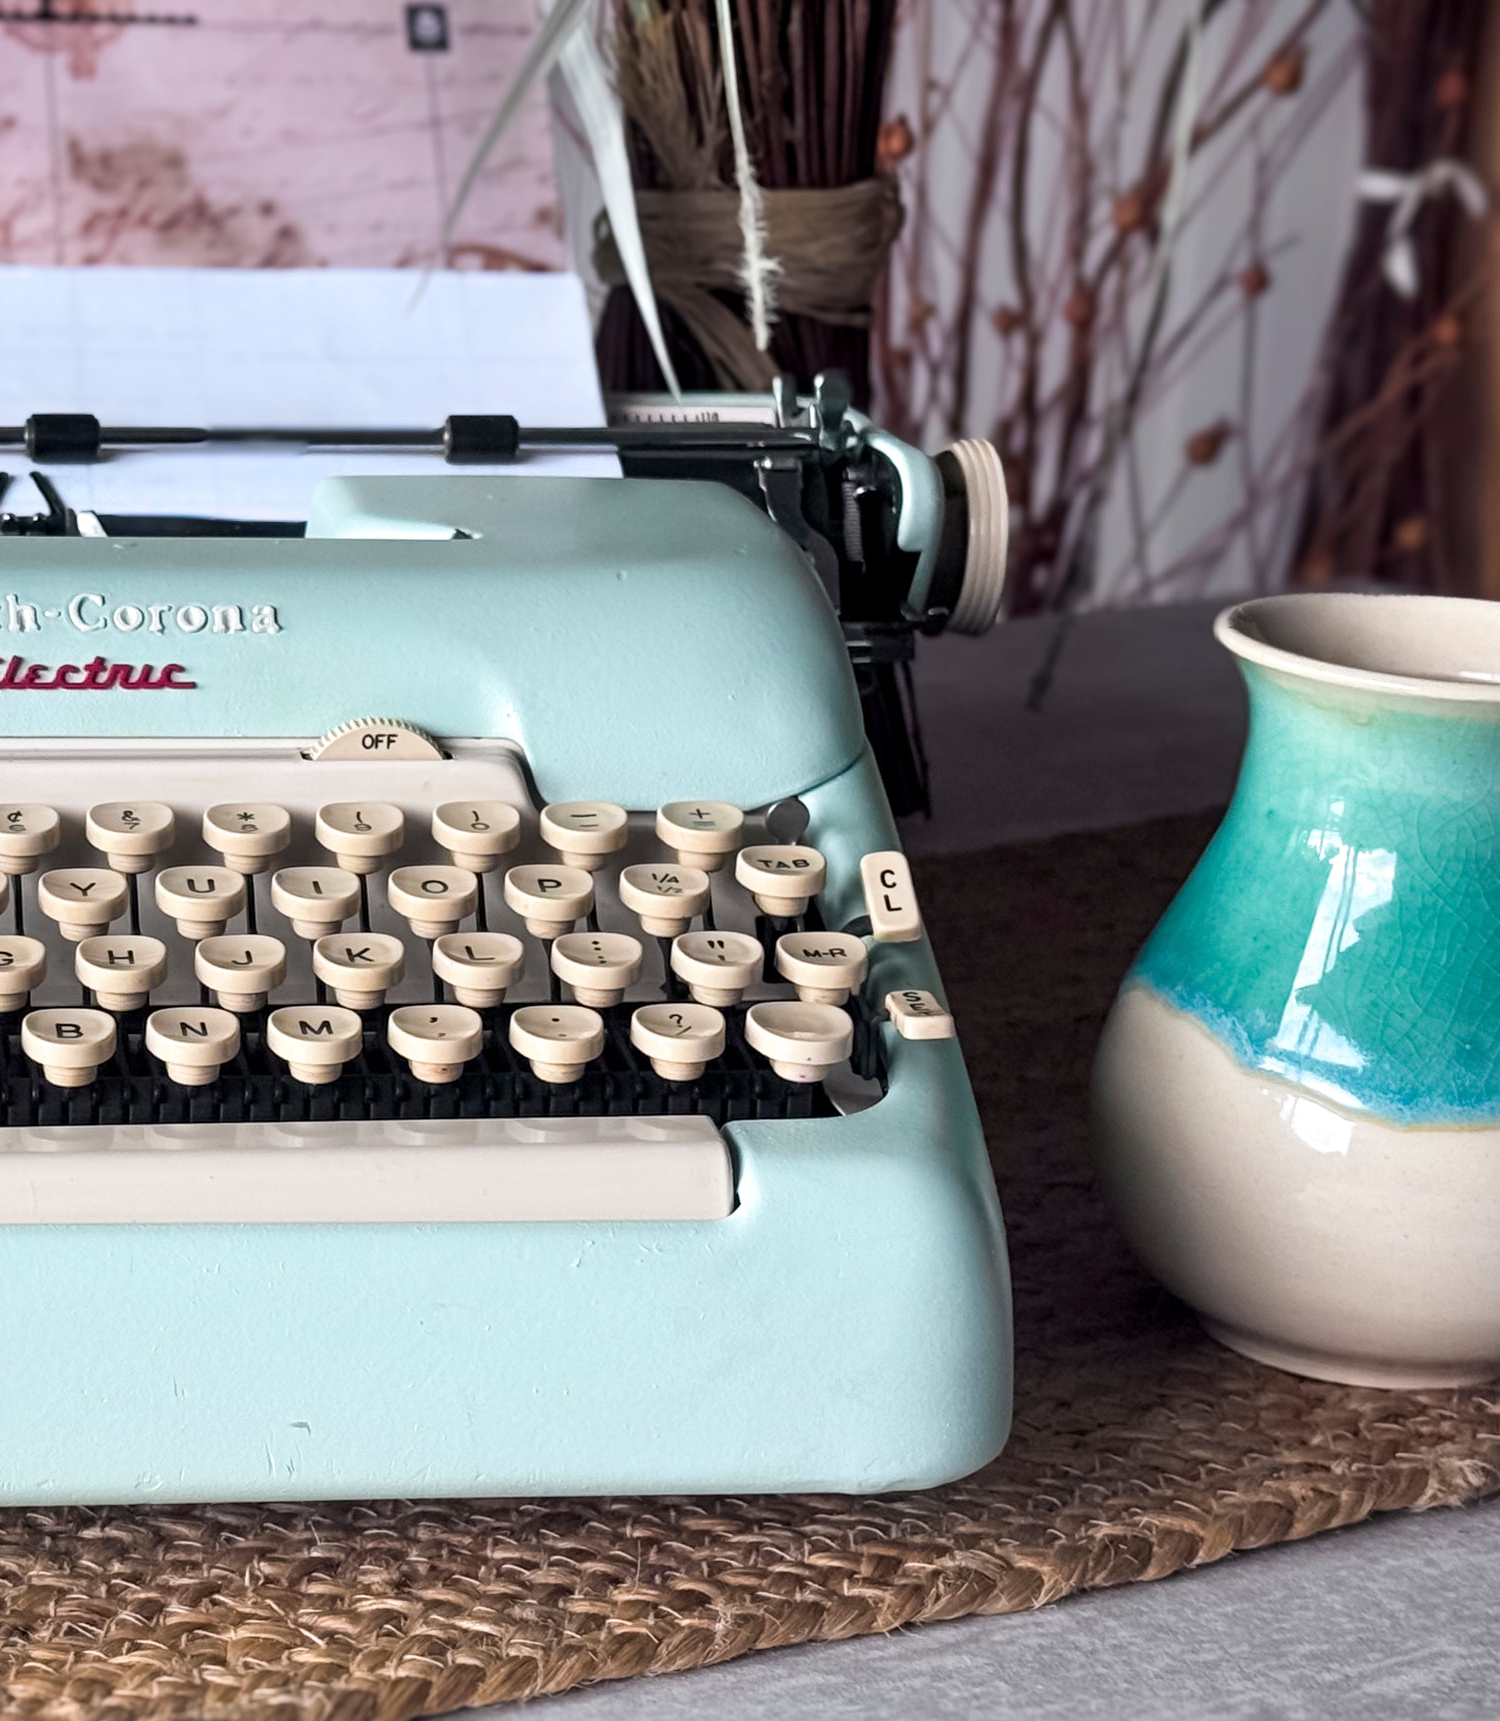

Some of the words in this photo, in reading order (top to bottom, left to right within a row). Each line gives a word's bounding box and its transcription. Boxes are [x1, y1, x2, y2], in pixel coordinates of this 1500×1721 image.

[362, 734, 398, 749] OFF
[121, 810, 140, 822] &
[689, 809, 710, 819] +
[758, 859, 809, 870] TAB
[70, 882, 96, 896] Y
[187, 878, 215, 893] U
[421, 880, 449, 893] O
[538, 879, 562, 892] P
[107, 950, 135, 964] H
[232, 950, 253, 965] J
[345, 948, 374, 962] K
[465, 945, 495, 961] L
[803, 948, 847, 959] M-R
[299, 1020, 333, 1035] M
[669, 1014, 683, 1028] ?
[55, 1023, 83, 1038] B
[180, 1021, 208, 1037] N
